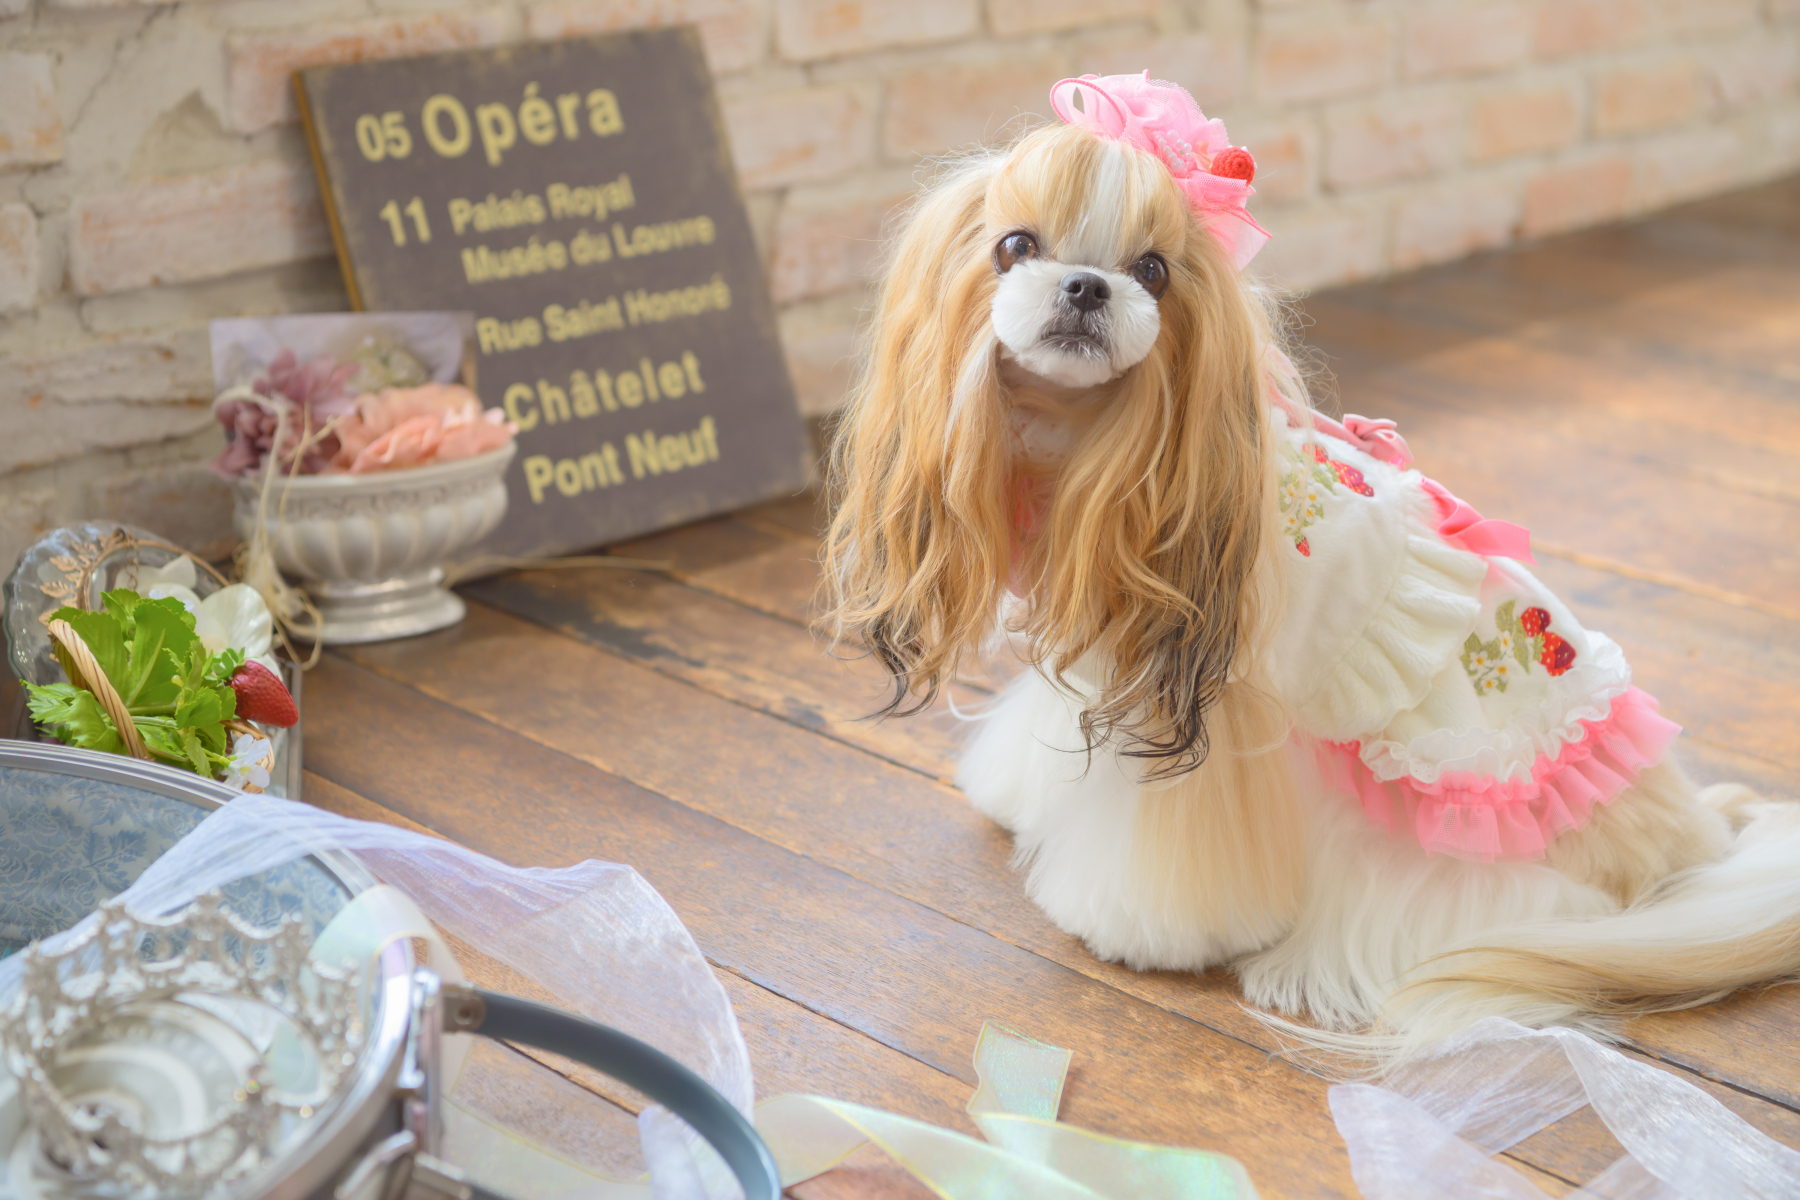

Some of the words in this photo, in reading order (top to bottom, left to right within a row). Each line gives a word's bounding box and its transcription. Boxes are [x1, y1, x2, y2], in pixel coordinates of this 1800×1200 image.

[356, 112, 411, 160] 05
[422, 82, 623, 164] Opéra
[380, 198, 430, 245] 11
[449, 191, 544, 234] Palais
[547, 175, 633, 219] Royal
[462, 237, 566, 282] Musée
[570, 230, 611, 264] du
[613, 216, 715, 256] Louvre
[477, 318, 541, 354] Rue
[544, 297, 624, 341] Saint
[623, 274, 730, 324] Honoré
[504, 352, 704, 430] Châtelet
[524, 443, 624, 503] Pont
[626, 417, 718, 477] Neuf
